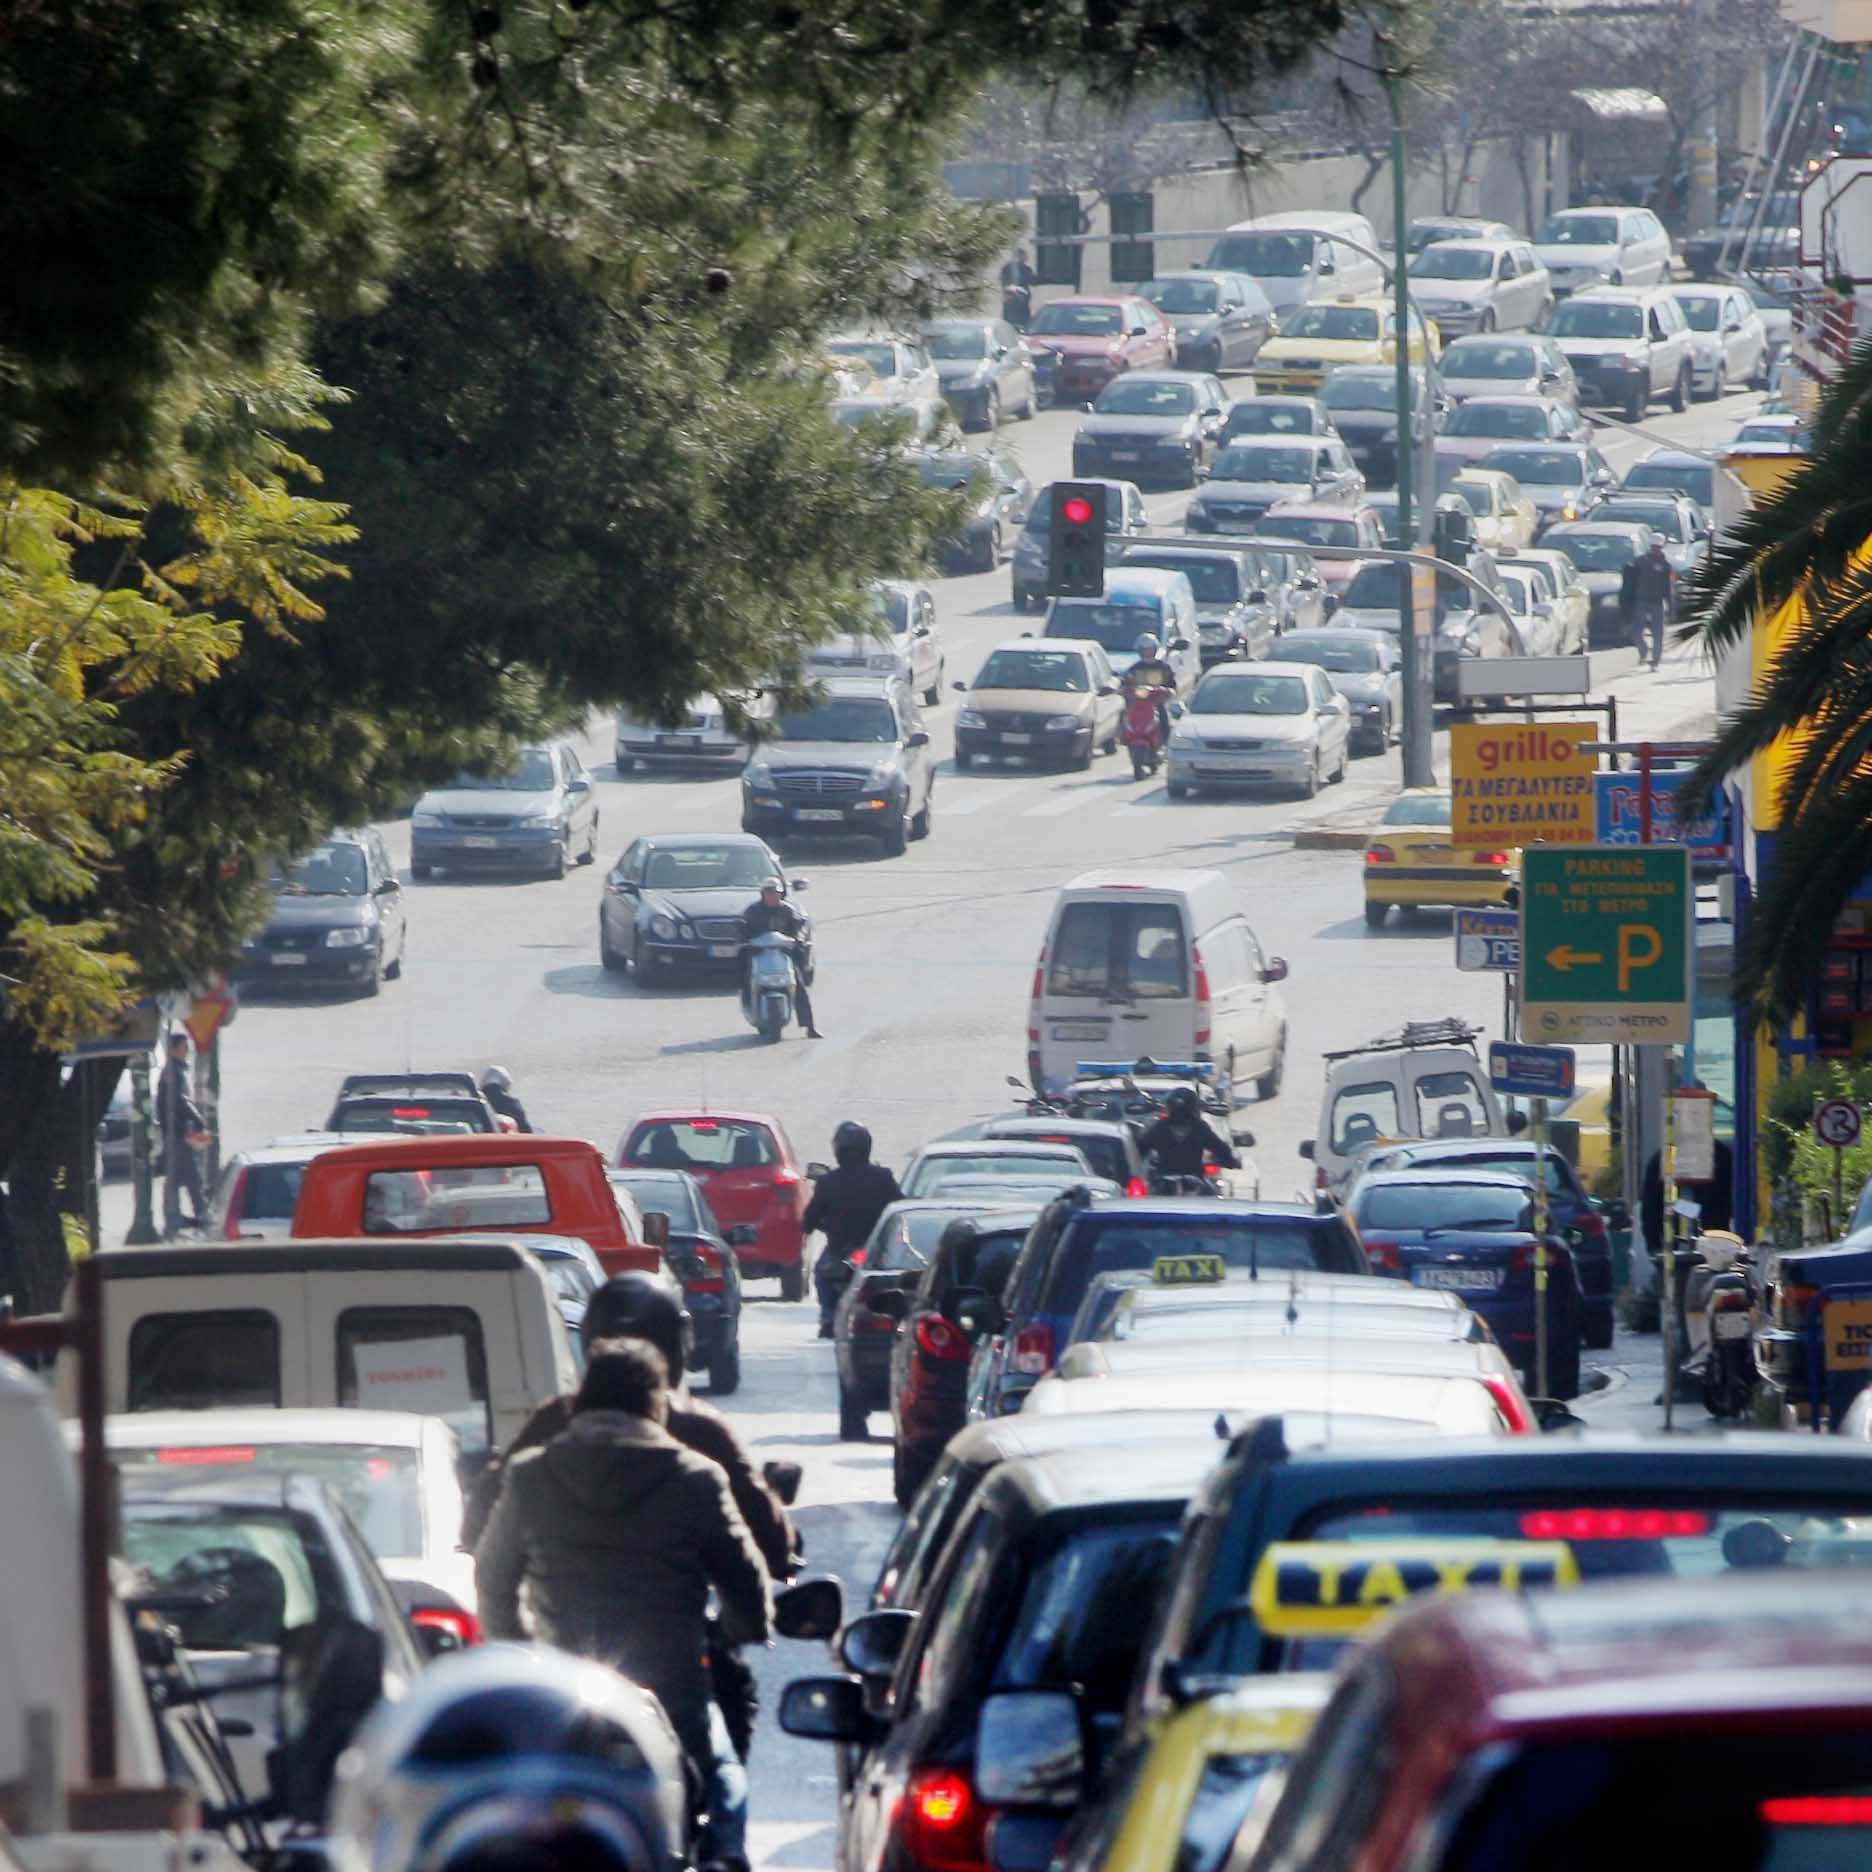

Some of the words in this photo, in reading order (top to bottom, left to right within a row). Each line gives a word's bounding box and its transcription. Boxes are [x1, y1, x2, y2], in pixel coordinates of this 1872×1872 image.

[1477, 731, 1573, 771] grillo
[1453, 778, 1476, 799] ΤΑ
[1468, 801, 1581, 825] ΣΟΥΒΛΑΚΙΑ
[1565, 858, 1646, 876] PARKING
[1616, 923, 1664, 992] P
[1159, 1258, 1220, 1280] TAXI
[1316, 1561, 1520, 1606] TAXI
